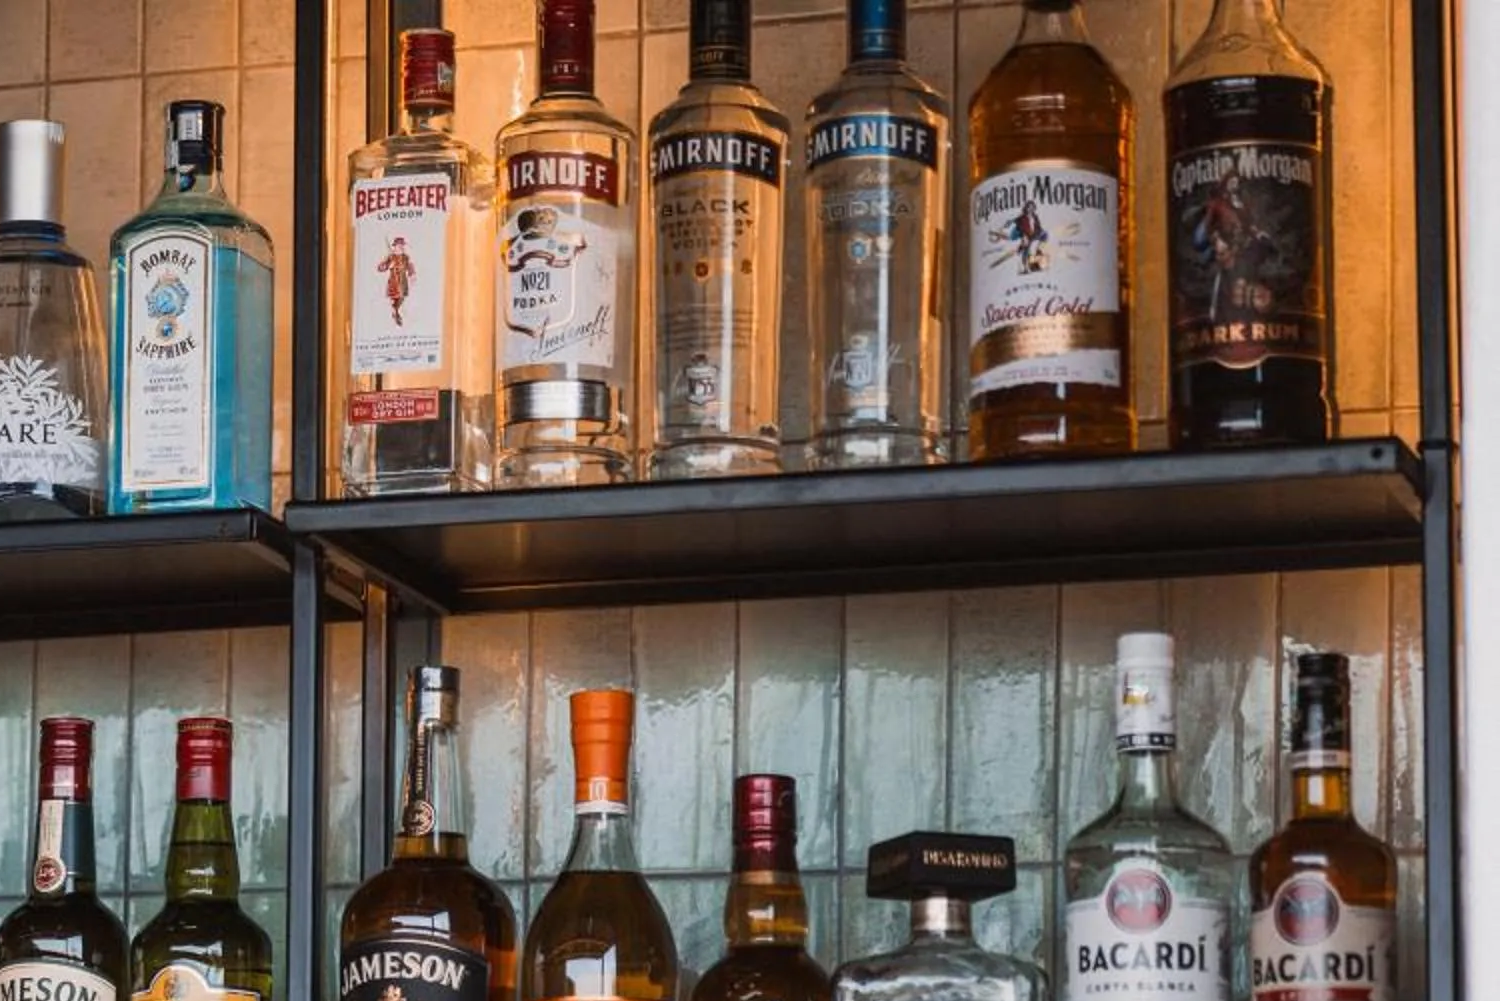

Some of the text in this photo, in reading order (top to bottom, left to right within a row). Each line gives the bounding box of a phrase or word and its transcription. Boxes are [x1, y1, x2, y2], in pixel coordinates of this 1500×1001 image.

[1173, 148, 1312, 197] Captain Morgan
[355, 183, 447, 219] BEEFEATER
[377, 210, 423, 221] LONDON
[661, 199, 749, 217] BLACK
[973, 176, 1107, 226] Captain Morgan
[140, 249, 196, 277] BOMBAY
[1045, 296, 1093, 316] Gold
[136, 334, 197, 360] SAPPHIRE
[1252, 321, 1298, 341] RUM
[1079, 935, 1207, 973] BACARDÍ
[1253, 946, 1376, 987] BACARDÍ
[342, 952, 465, 995] JAMESON
